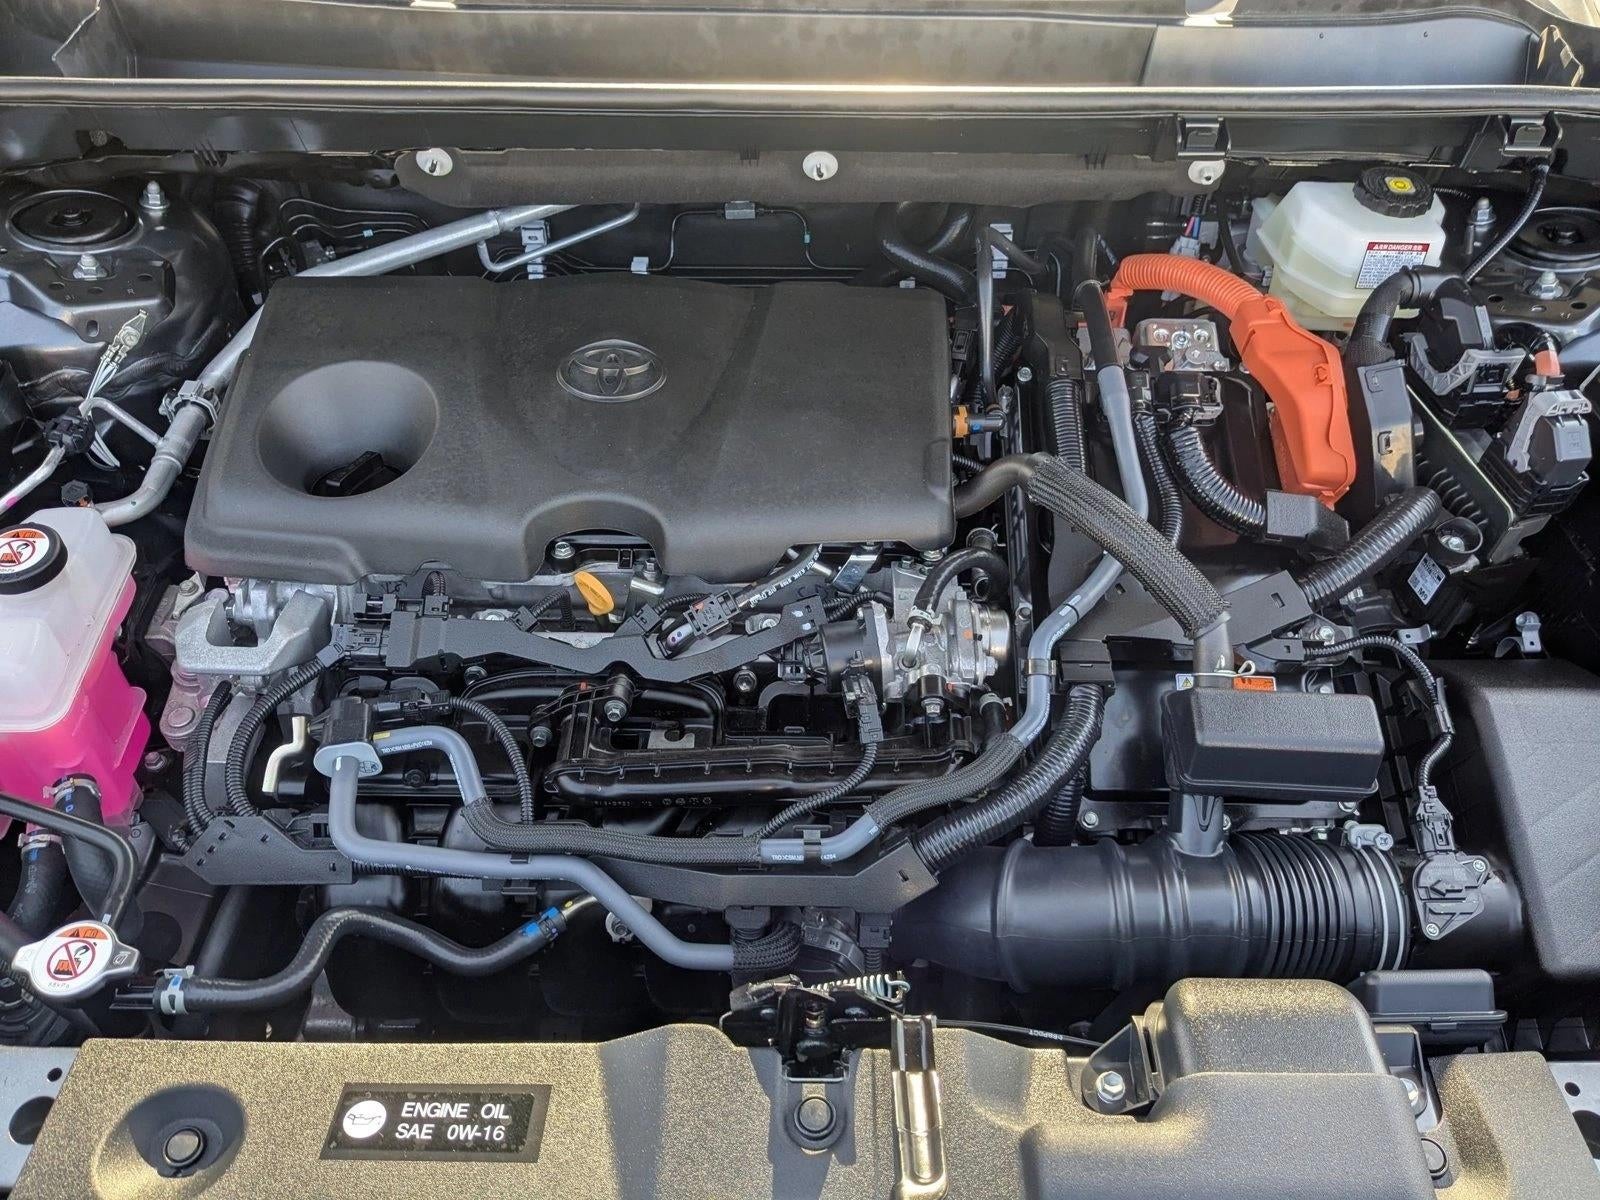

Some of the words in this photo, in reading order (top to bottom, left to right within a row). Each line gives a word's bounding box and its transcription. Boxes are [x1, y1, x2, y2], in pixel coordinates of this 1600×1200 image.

[1387, 243, 1413, 251] DANGER
[400, 1101, 470, 1119] ENGINE
[480, 1103, 511, 1119] OIL
[394, 1122, 436, 1140] SAE
[446, 1123, 506, 1141] 0W-16
